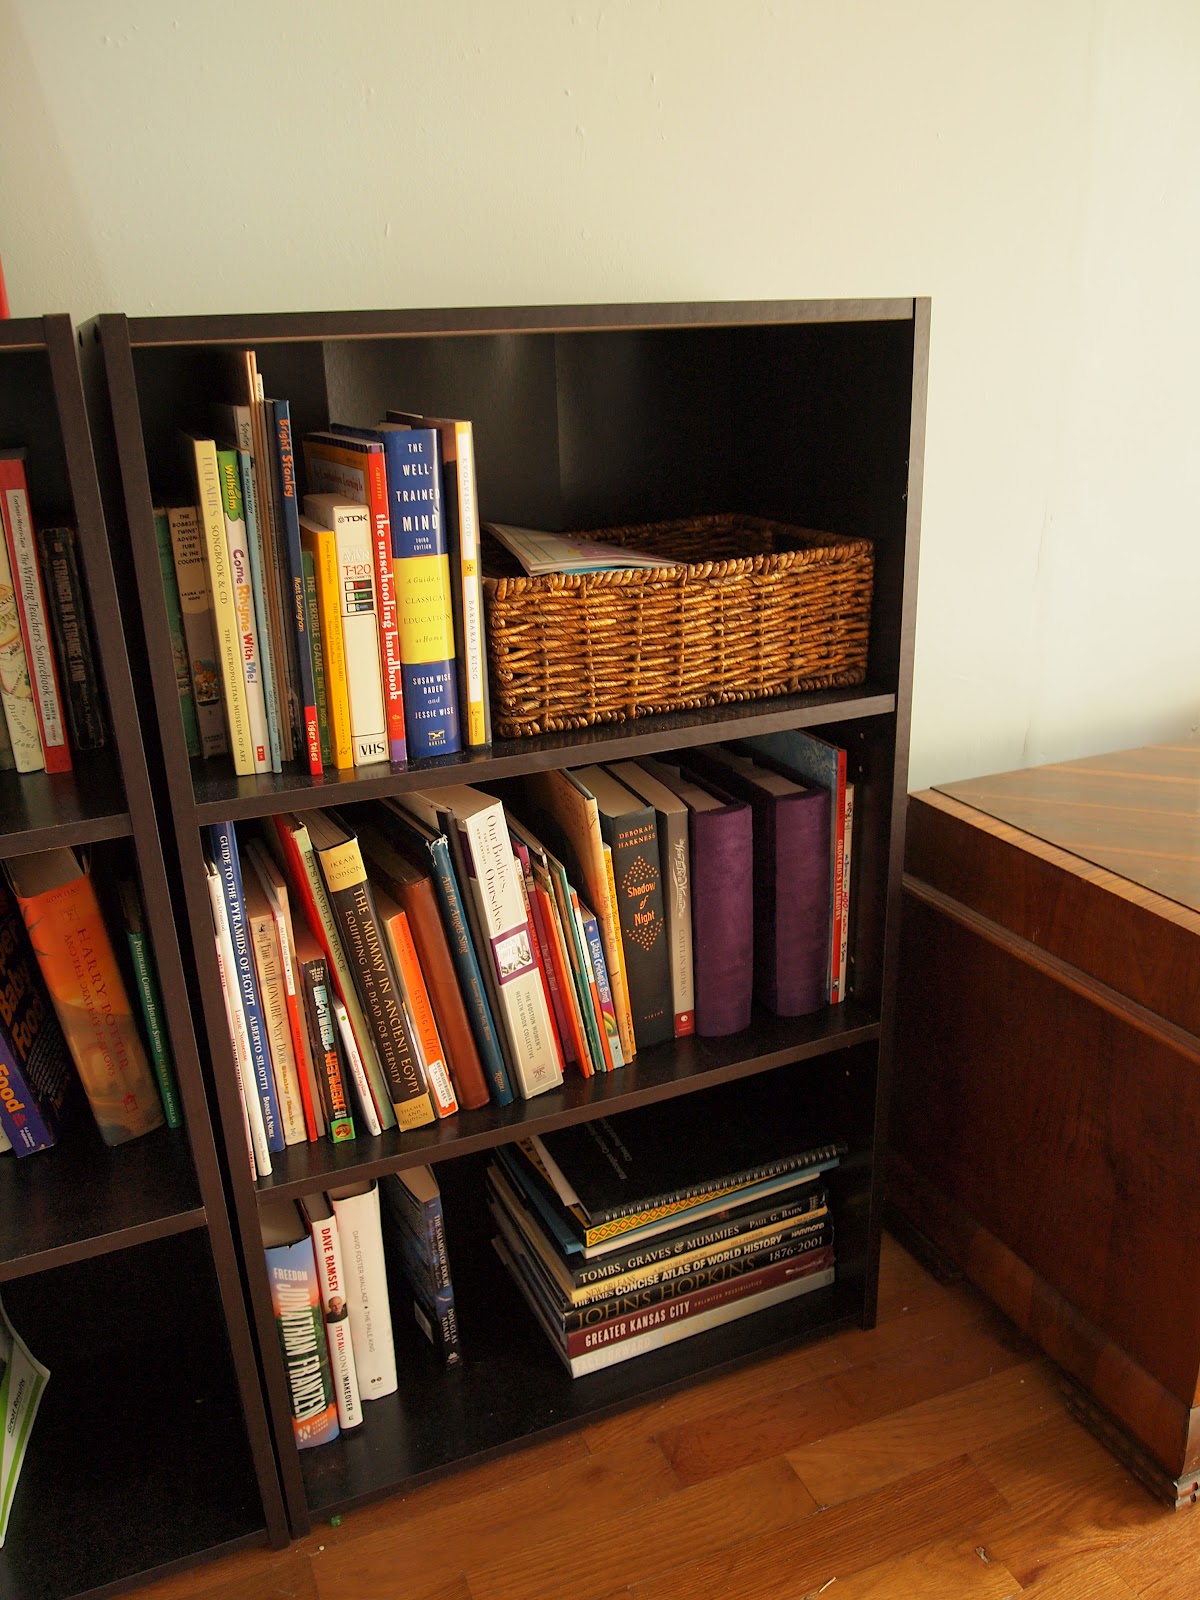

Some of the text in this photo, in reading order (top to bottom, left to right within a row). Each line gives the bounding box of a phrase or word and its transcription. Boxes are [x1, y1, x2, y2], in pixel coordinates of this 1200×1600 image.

[277, 419, 295, 497] Bright Stanley
[408, 443, 423, 453] THE
[223, 464, 238, 509] Wilhelm
[396, 488, 441, 502] TRAINED
[462, 457, 470, 511] EVOLVING
[344, 514, 368, 522] TDK
[375, 513, 389, 537] the
[402, 514, 439, 532] MIND
[20, 552, 29, 566] The
[211, 523, 227, 604] SONGBOOK & CD
[343, 564, 371, 576] T-120
[19, 566, 35, 600] Writing
[376, 541, 396, 628] unschooling
[405, 594, 447, 605] CLASSICAL
[232, 549, 257, 684] Come Rhyme With Me!
[306, 574, 323, 671] THE TERRIBLE GAME
[403, 613, 450, 625] EDUCATION
[423, 635, 443, 643] Home
[35, 644, 52, 695] Sourcebook
[226, 646, 238, 701] METROPOLITAN
[384, 631, 402, 699] handbook
[427, 696, 440, 704] and
[234, 704, 242, 734] MUSEUM
[237, 737, 244, 746] OF
[307, 719, 318, 761] tiger tales
[360, 743, 386, 756] VHS
[618, 824, 654, 839] DEBORAH
[618, 833, 656, 849] HARKNESS
[485, 814, 510, 892] Our Bodies,
[484, 868, 504, 930] Ourselves
[627, 881, 656, 898] Shadow
[639, 895, 649, 910] of
[219, 834, 254, 1006] GUIDE TO THE PYRAMIDS OF EGYPT
[303, 850, 346, 972] LET'S TRAVEL IN FRANCE
[441, 875, 469, 953] And the Angels Sing
[634, 910, 656, 926] Night
[133, 940, 148, 975] POLITICALLY
[260, 943, 271, 959] THE
[678, 929, 686, 964] CAITLIN
[543, 958, 553, 975] Early
[548, 976, 557, 991] Bird
[589, 938, 602, 958] Little
[598, 986, 609, 1002] Song
[76, 927, 128, 1069] HARRY POTTER
[141, 976, 153, 1003] CORRECT
[263, 961, 281, 1019] MILLIONAIRE
[344, 910, 401, 1083] EQUIPPING THE DEAD FOR ETERNITY
[352, 888, 419, 1093] THE MUMMY IN ANCIENT EGYPT
[146, 1003, 159, 1029] HOLIDAY
[272, 1021, 283, 1041] NEXT
[414, 989, 427, 1024] GETTING
[422, 1037, 439, 1055] life
[514, 991, 534, 1059] HEALTH BOOK COLLECTIVE
[527, 1003, 536, 1024] BOSTON
[234, 1009, 249, 1061] Lizzie Nonsense
[249, 1014, 267, 1090] ALBERTO SILIOTTI
[531, 1025, 541, 1050] WOMEN'S
[275, 1043, 287, 1065] DOOR
[280, 1065, 290, 1094] Stanley
[323, 1051, 346, 1109] HEINLEIN
[433, 1215, 441, 1228] THE
[435, 1228, 445, 1255] SALMON
[580, 1262, 625, 1285] TOMBS,
[627, 1247, 671, 1269] GRAVES
[672, 1241, 686, 1254] &
[686, 1225, 740, 1249] MUMMIES
[748, 1217, 768, 1229] PAUL
[273, 1267, 308, 1281] FREEDOM
[319, 1227, 340, 1292] DAVE RAMSEY
[351, 1230, 368, 1302] DAVID FOSTER WALLACE
[614, 1274, 660, 1297] CONCISE
[660, 1263, 692, 1282] ATLAS
[691, 1259, 707, 1271] OF
[707, 1248, 742, 1266] WORLD
[742, 1234, 783, 1255] HISTORY
[576, 1289, 652, 1327] JOHNS
[658, 1256, 756, 1301] HOPKINS
[768, 1236, 823, 1261] 1876-2001
[276, 1283, 318, 1357] JONATHAN
[364, 1323, 373, 1337] PALE
[440, 1316, 451, 1341] ADAMS
[446, 1308, 459, 1343] DOUGLAS
[583, 1322, 627, 1347] GREATER
[628, 1309, 666, 1331] KANSAS
[667, 1301, 690, 1318] CITY
[366, 1338, 375, 1352] KING
[287, 1352, 327, 1423] FRANZEN
[342, 1376, 353, 1410] MAKEOVER
[5, 1378, 25, 1434] Great Results
